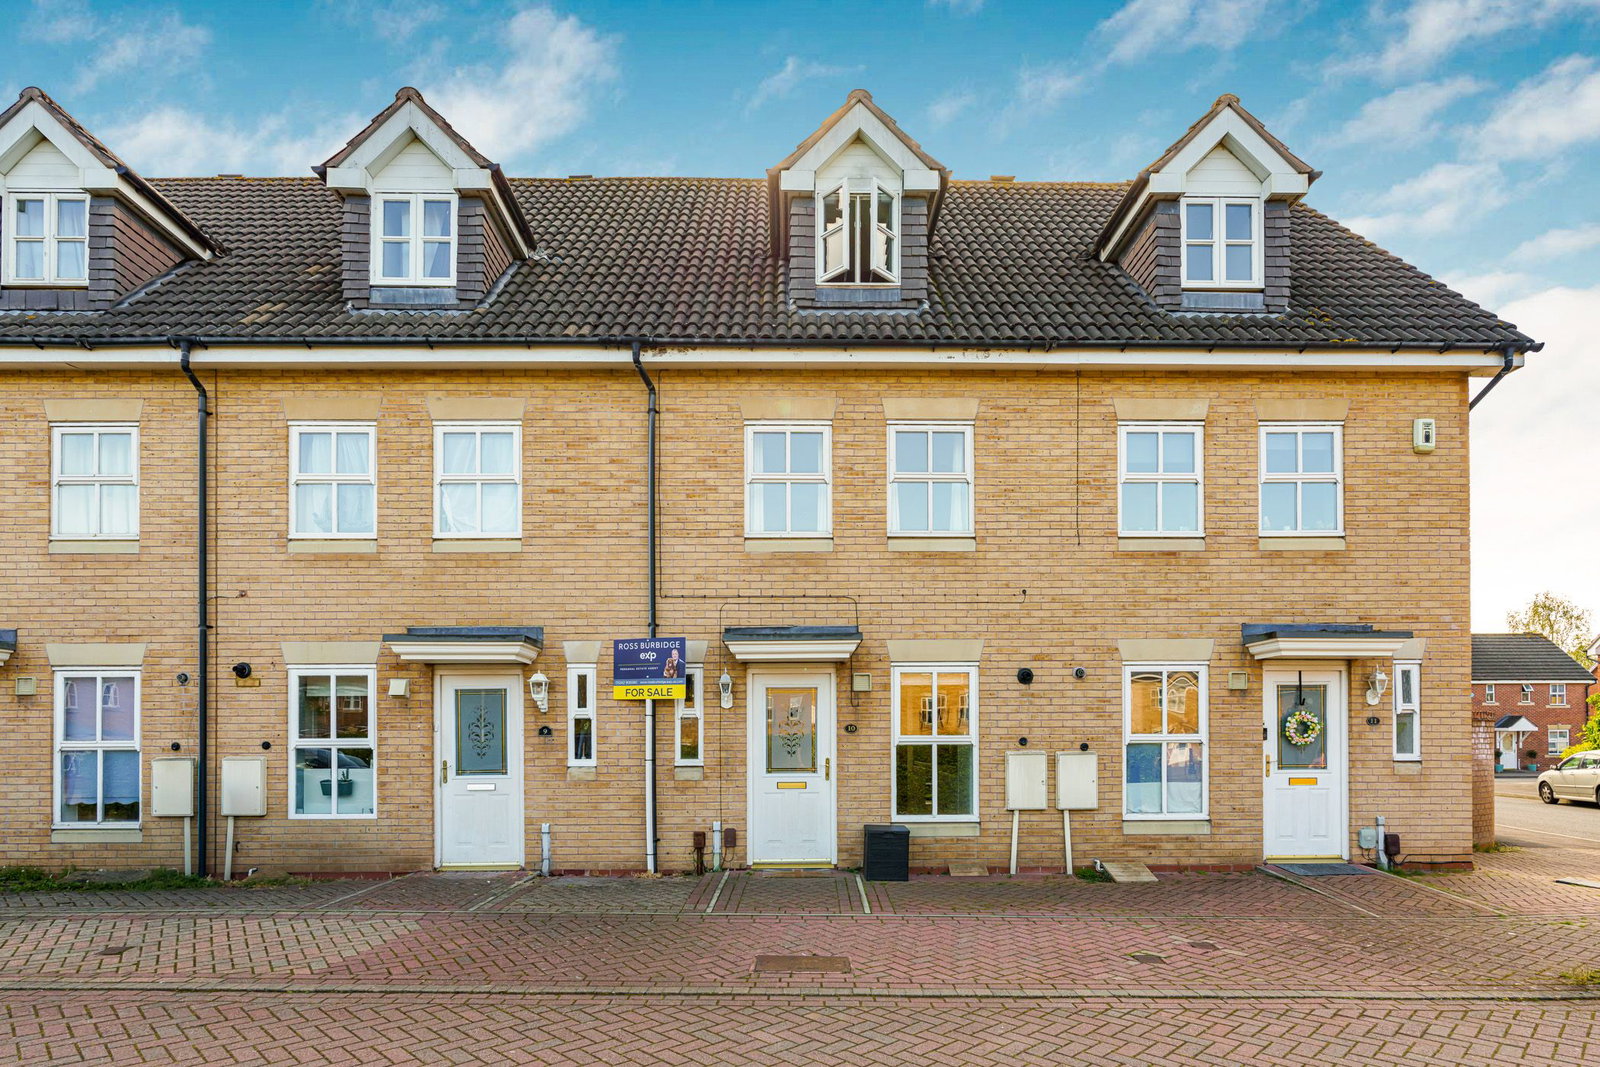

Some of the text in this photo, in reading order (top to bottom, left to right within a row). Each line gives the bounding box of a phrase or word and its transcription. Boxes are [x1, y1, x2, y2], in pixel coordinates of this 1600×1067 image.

[618, 640, 680, 650] ROSS BURBIDGE
[640, 651, 656, 662] exp
[625, 688, 673, 697] FOR SALE
